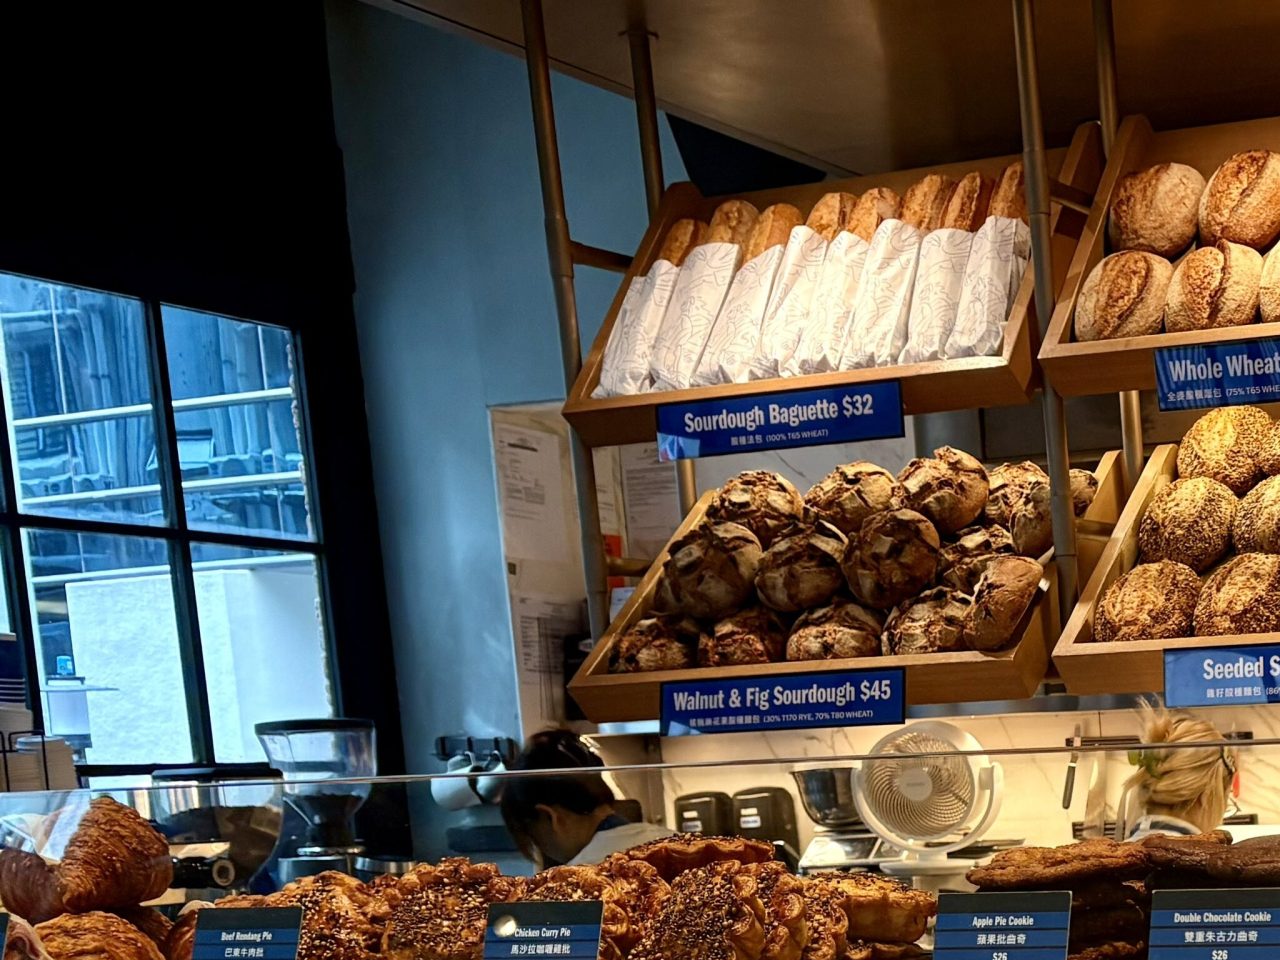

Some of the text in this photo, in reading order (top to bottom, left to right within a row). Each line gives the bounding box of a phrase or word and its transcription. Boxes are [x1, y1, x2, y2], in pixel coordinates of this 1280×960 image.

[1169, 358, 1222, 382] Whole
[1226, 352, 1280, 377] Wheat
[684, 394, 873, 432] Sourdough Baguette $32
[802, 429, 828, 438] WHEAT)
[1203, 656, 1264, 679] Seeded
[673, 680, 891, 711] Walnut & Fig Sourdough $45
[972, 916, 1034, 928] Apple Pie Cookie
[1174, 912, 1271, 922] Double Chocolate Cookie
[221, 932, 235, 940] Beef
[262, 931, 272, 940] Pie
[514, 928, 571, 938] Chicken Curry Pie
[1212, 950, 1228, 960] $26
